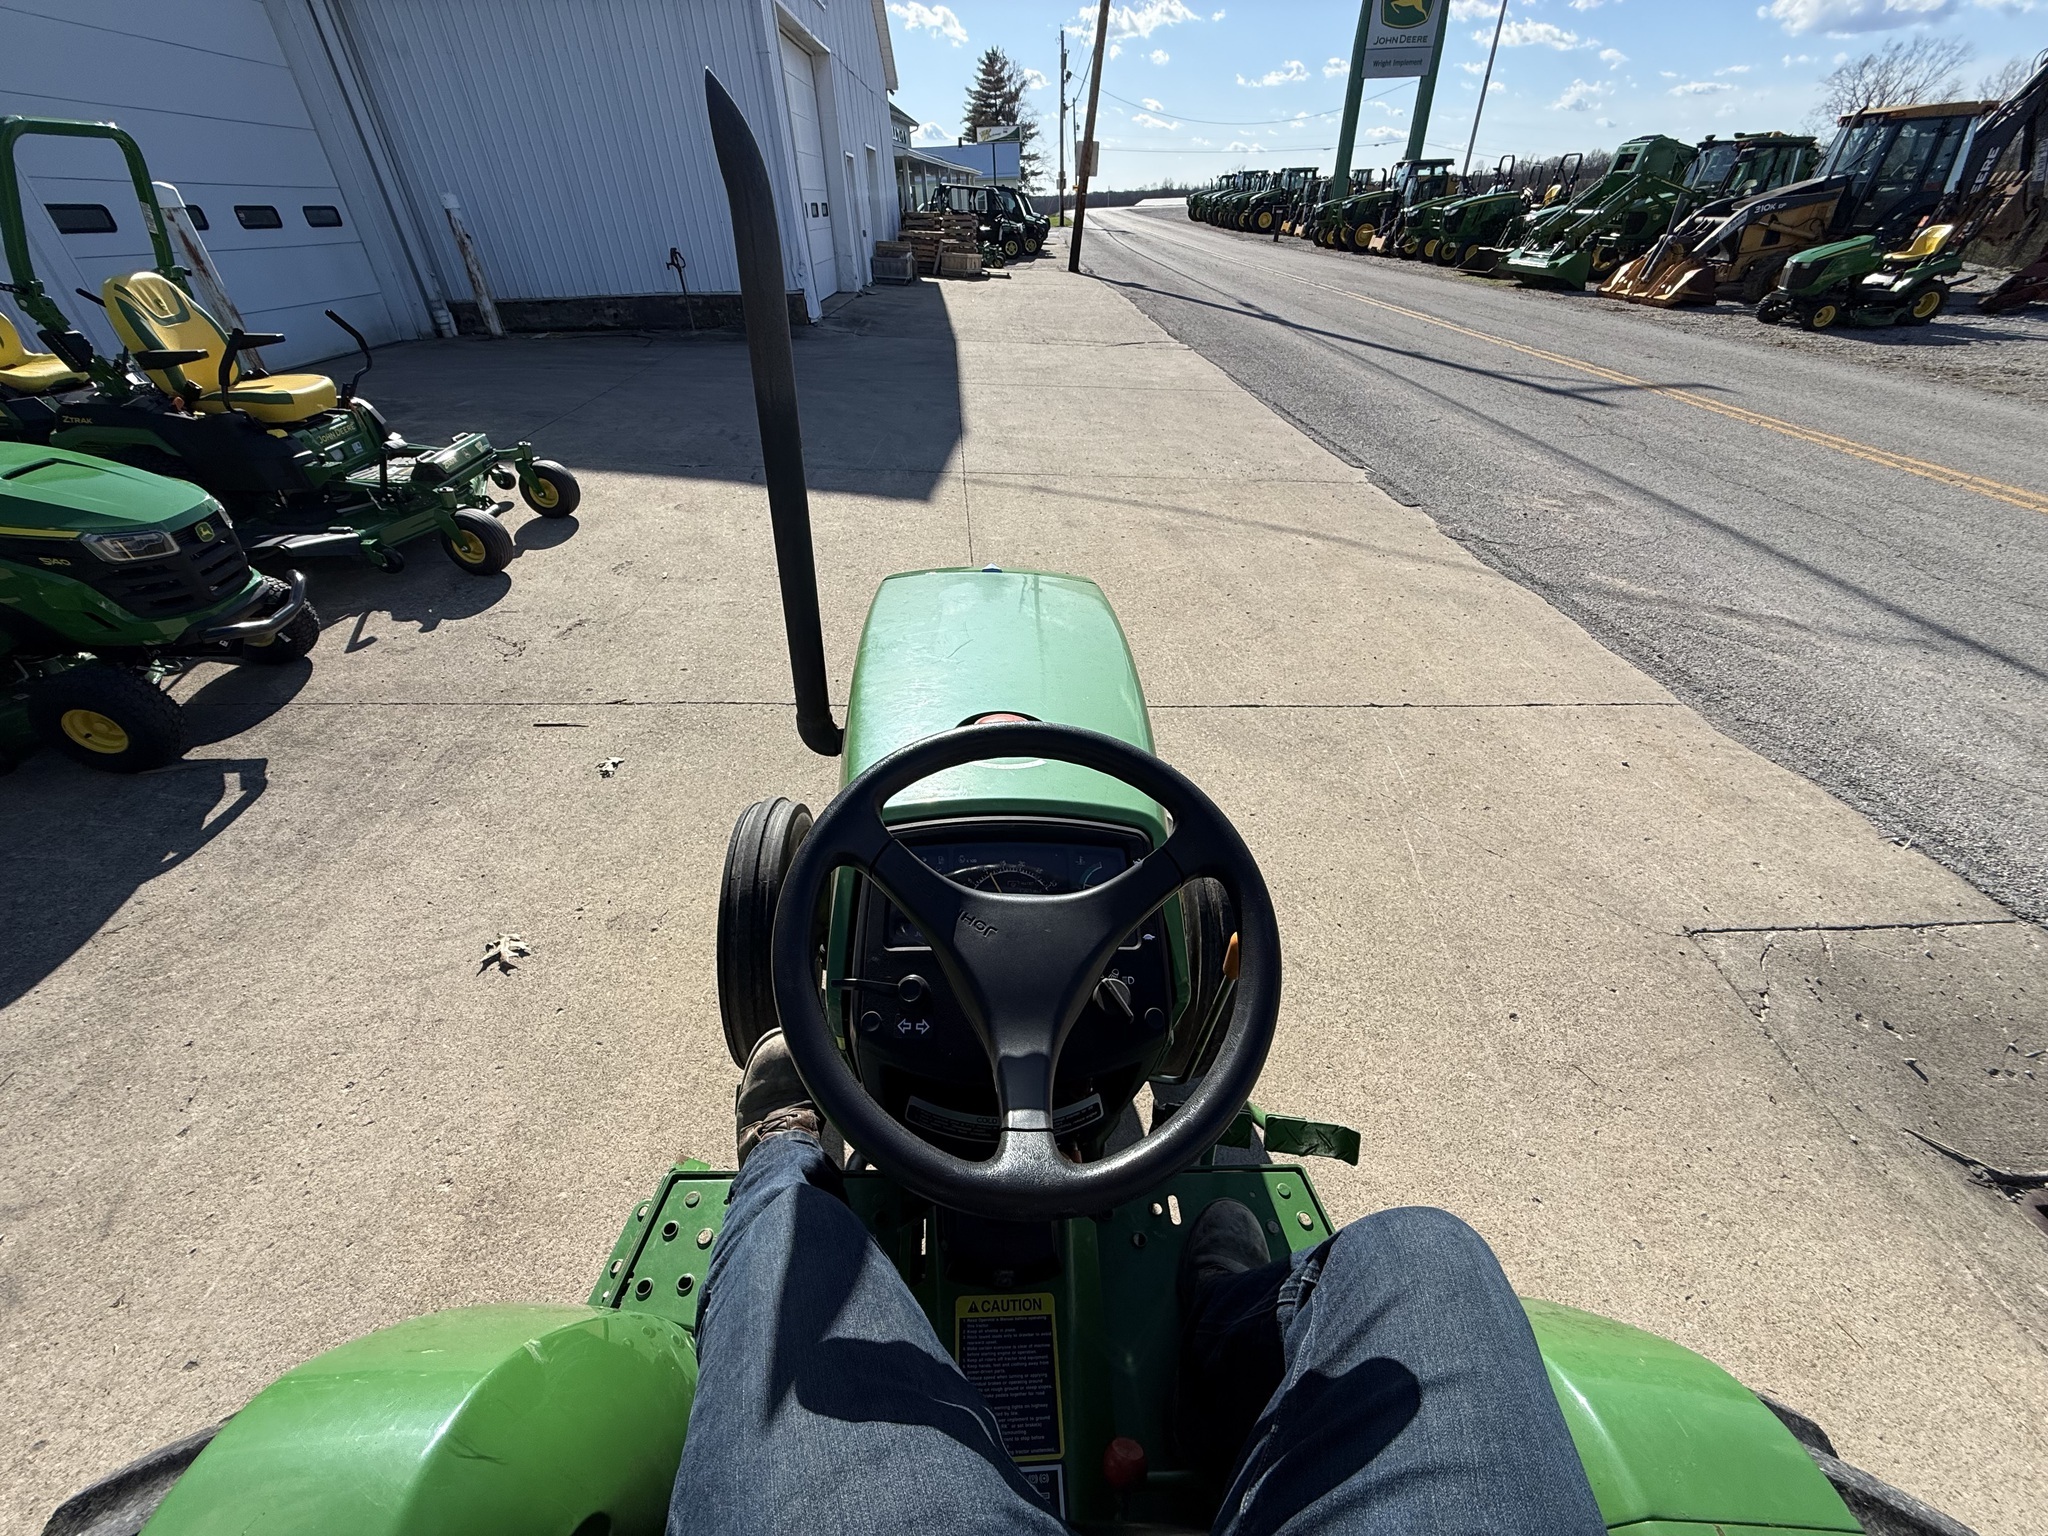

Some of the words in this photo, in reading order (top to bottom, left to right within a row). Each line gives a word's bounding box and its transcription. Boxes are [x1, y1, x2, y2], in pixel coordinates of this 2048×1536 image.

[1373, 36, 1397, 45] JOHN
[1399, 35, 1428, 44] DEERE
[1373, 60, 1391, 68] Wright
[1393, 58, 1423, 68] Implement
[1754, 203, 1776, 214] 310K
[62, 415, 94, 424] ZTRAK
[319, 432, 336, 444] JOHN
[336, 421, 356, 437] DEERE
[958, 909, 999, 938] JOH
[977, 1117, 997, 1125] COLD
[981, 1298, 1042, 1313] CAUTION
